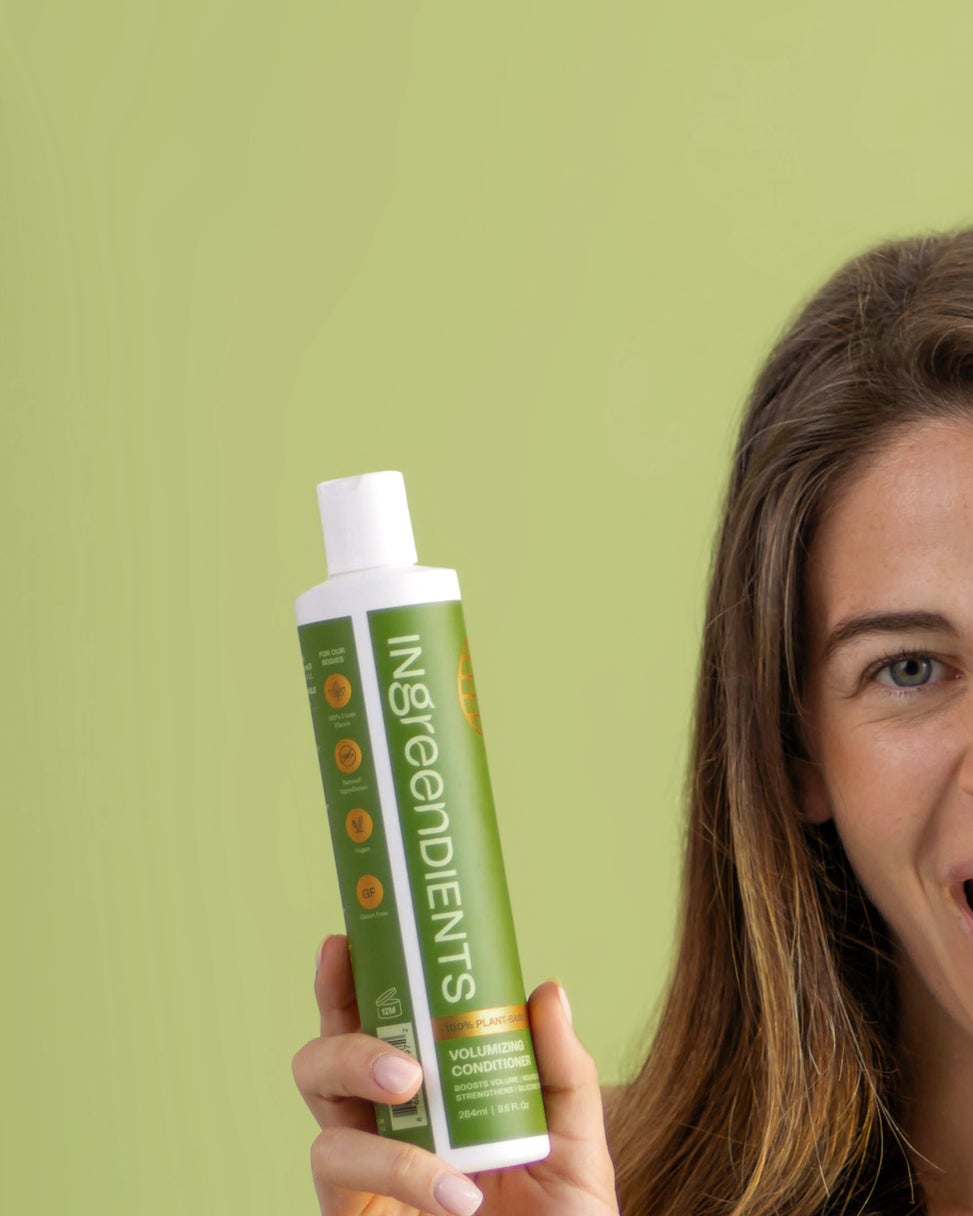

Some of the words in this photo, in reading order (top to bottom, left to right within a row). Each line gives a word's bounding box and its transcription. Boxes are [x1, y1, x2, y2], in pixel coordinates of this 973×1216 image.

[319, 650, 331, 658] FOR
[331, 647, 346, 656] OUR
[387, 634, 476, 1005] INgreenDIENTS
[362, 887, 376, 899] GF
[381, 1006, 396, 1015] 12M
[445, 1020, 474, 1033] 100%
[448, 1039, 525, 1061] VOLUMIZING
[451, 1054, 532, 1077] CONDITIONER
[454, 1080, 489, 1092] BOOSTS
[490, 1075, 519, 1086] VOLUME
[455, 1087, 514, 1102] STRENGTHENS
[458, 1107, 488, 1119] 284ml
